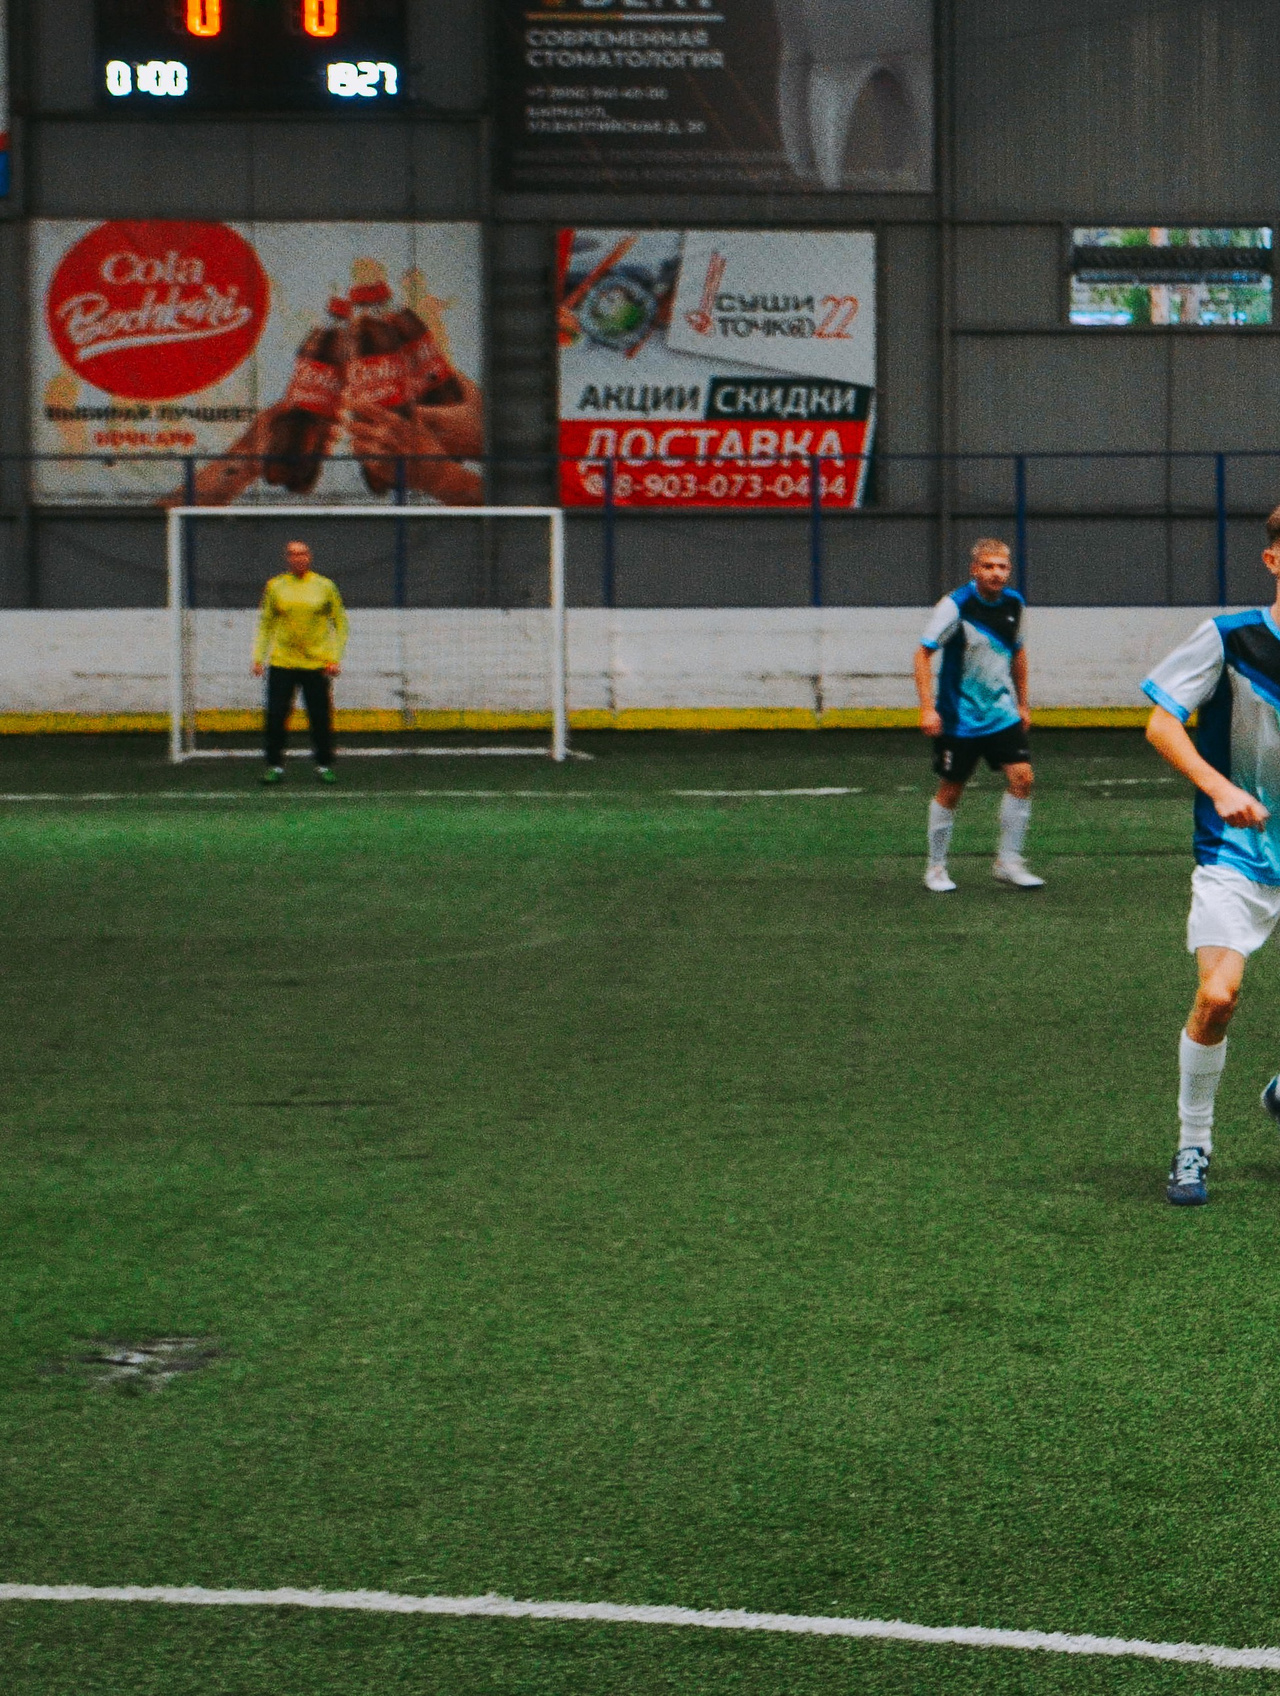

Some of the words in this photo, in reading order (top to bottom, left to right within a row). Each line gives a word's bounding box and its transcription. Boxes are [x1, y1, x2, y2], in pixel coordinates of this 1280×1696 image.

[526, 29, 709, 47] СОВРЕМЕННАЯ
[526, 50, 725, 68] СТОМАТОЛОГИЯ
[102, 249, 205, 285] Cola
[814, 294, 860, 339] 22
[577, 384, 701, 415] АКЦИИ
[714, 386, 856, 418] СКИДКИ
[578, 428, 846, 473] ДОСТАВКА
